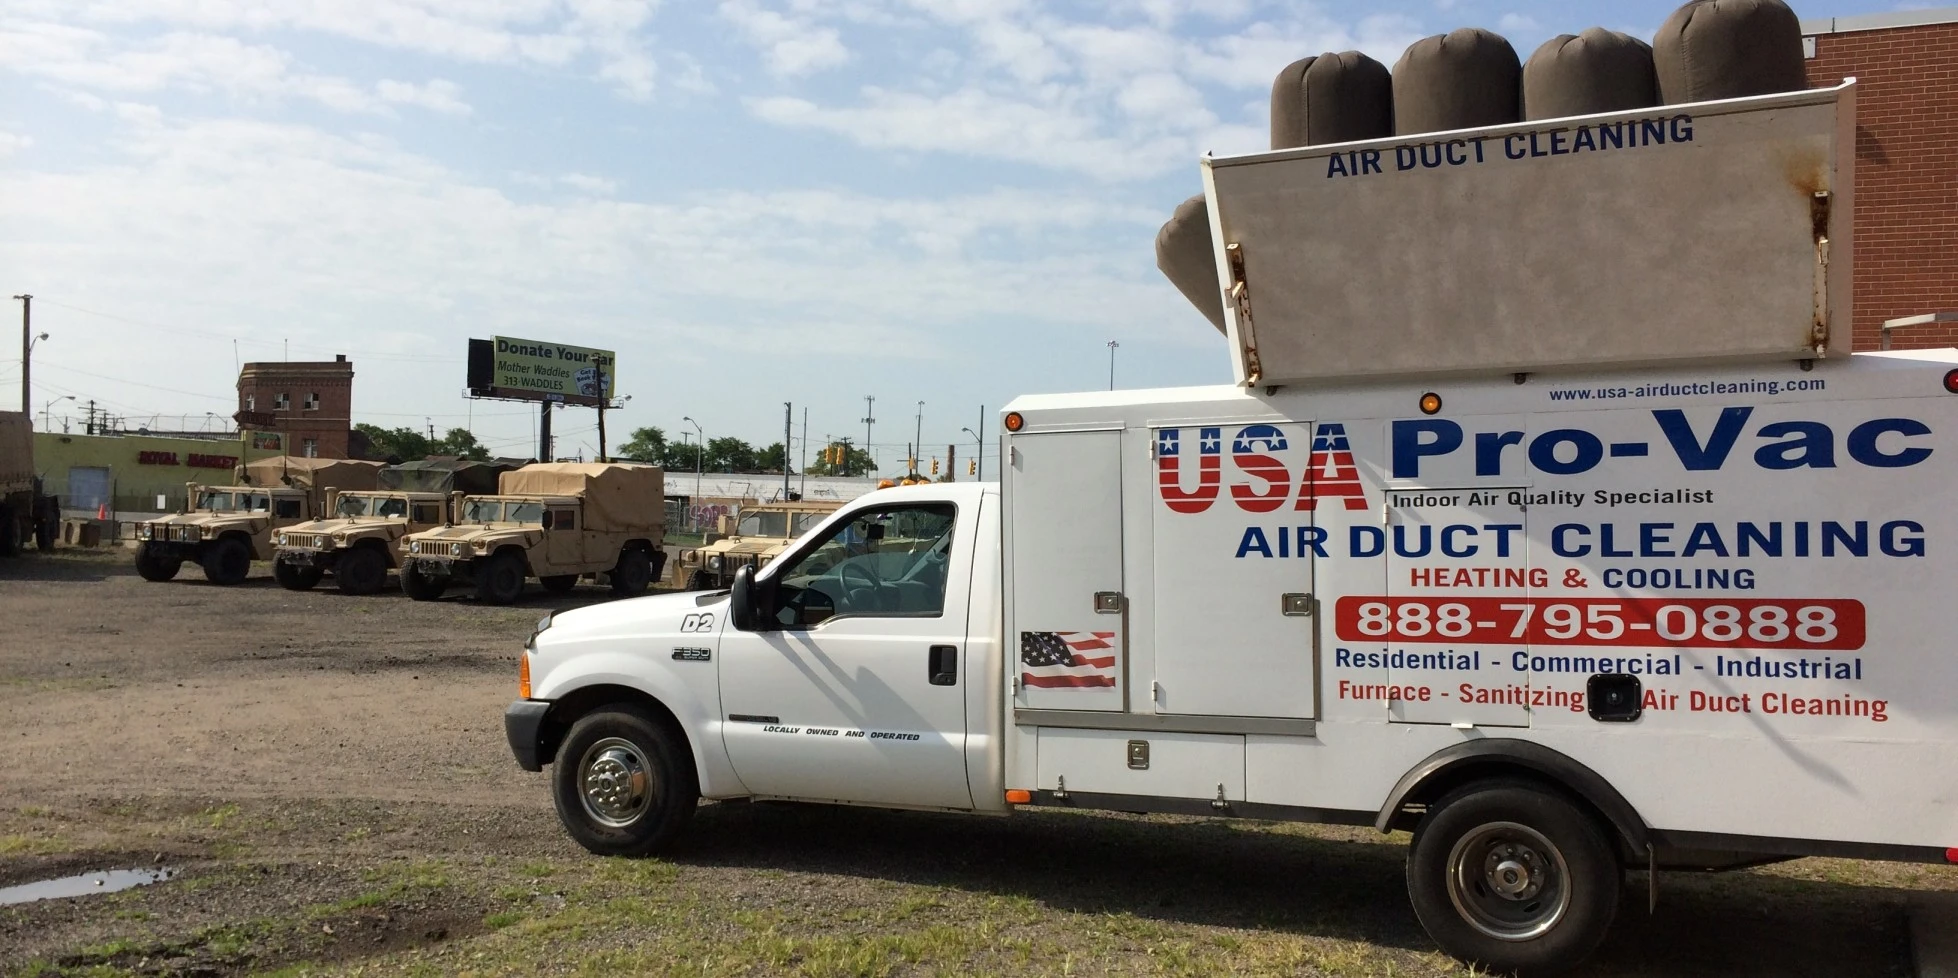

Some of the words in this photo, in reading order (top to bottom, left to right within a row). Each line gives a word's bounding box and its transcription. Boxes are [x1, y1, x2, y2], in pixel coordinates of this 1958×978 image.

[1327, 148, 1382, 178] AIR
[1396, 136, 1489, 171] DUCT
[1504, 114, 1693, 161] CLEANING
[498, 340, 553, 359] Donate
[556, 347, 589, 363] Your
[498, 361, 530, 374] Mother
[534, 364, 570, 378] Waddles
[1549, 377, 1826, 401] www.usa-airductcleaning.com
[1392, 406, 1934, 479] Pro-Vac
[1159, 423, 1368, 514] USA
[1392, 493, 1460, 508] Indoor
[1468, 492, 1499, 507] Air
[1507, 490, 1585, 508] Quality
[1594, 489, 1714, 507] Specialist
[1234, 526, 1329, 558] AIR
[1350, 524, 1522, 558] DUCT
[1551, 519, 1925, 558] CLEANING
[1410, 568, 1548, 588] HEATING
[1562, 568, 1588, 588] &
[1603, 568, 1755, 589] COOLING
[680, 612, 714, 633] D2
[1357, 602, 1838, 643] 888-795-0888
[1335, 648, 1479, 670] Residential
[1512, 651, 1680, 675] Commercial
[1717, 656, 1862, 680] Industrial
[1339, 680, 1431, 702] Furnace
[1459, 683, 1585, 712] Sanitizing
[1641, 690, 1679, 711] Air
[1690, 690, 1751, 713] Duct
[1762, 692, 1888, 722] Cleaning
[763, 725, 800, 734] LOCALLY
[806, 728, 839, 736] OWNED
[845, 730, 865, 738] AND
[870, 731, 920, 741] OPERATED
